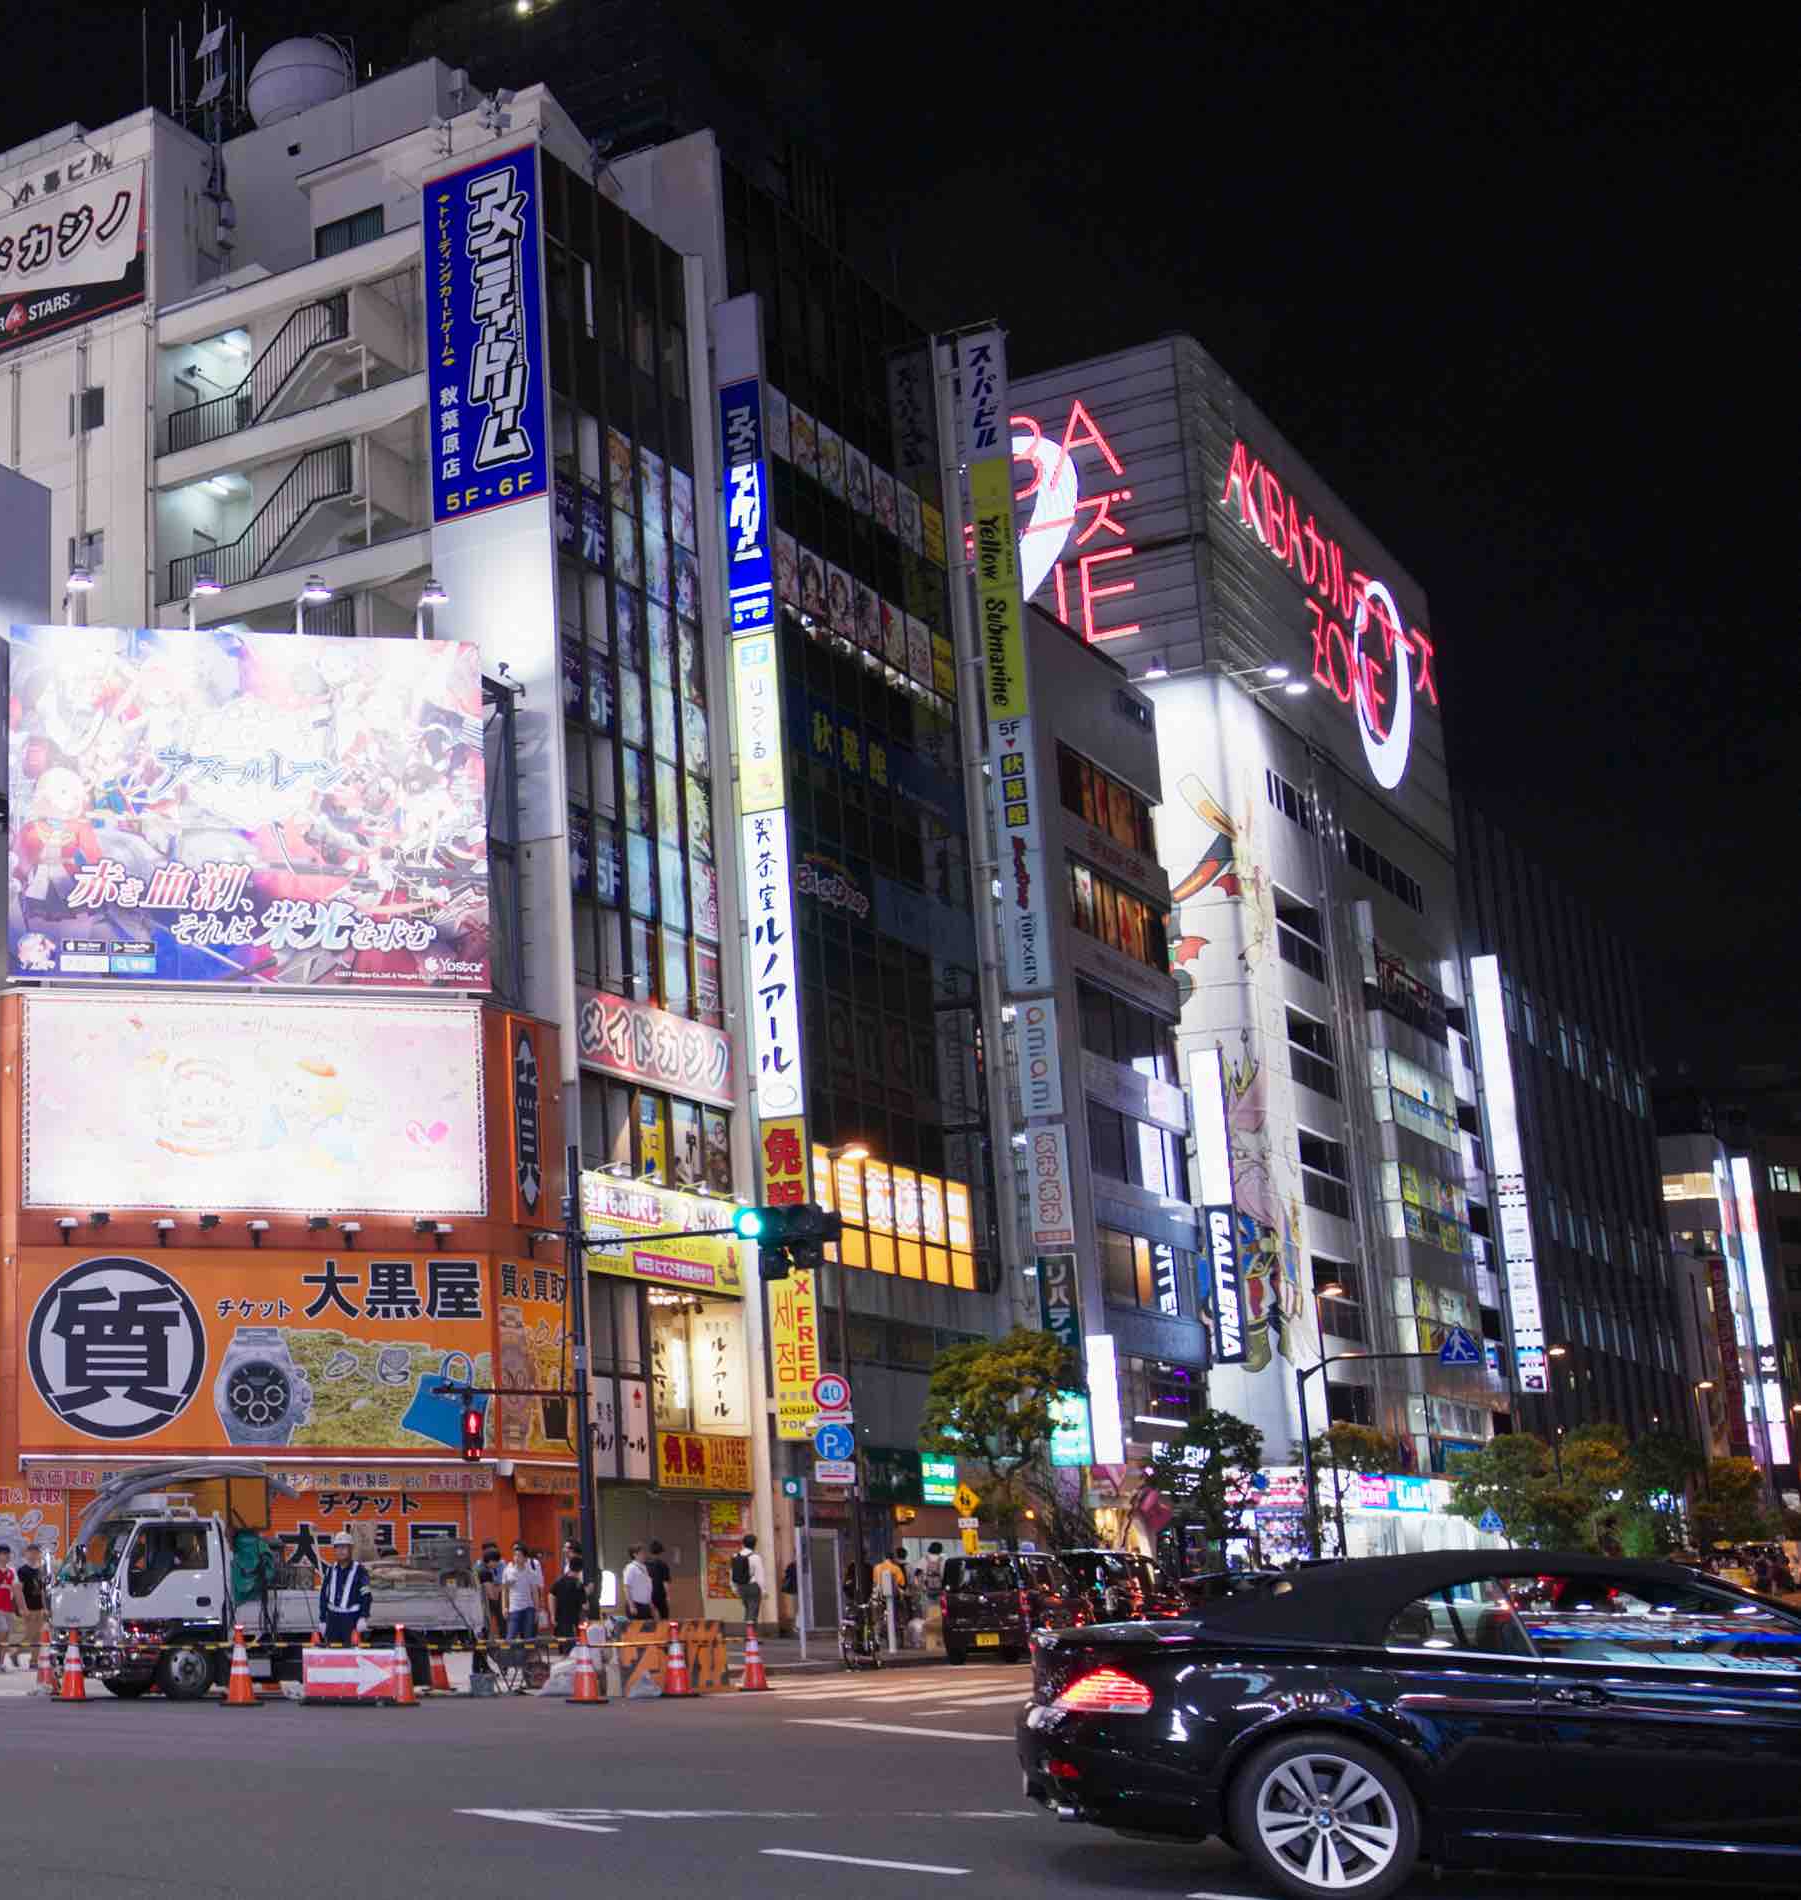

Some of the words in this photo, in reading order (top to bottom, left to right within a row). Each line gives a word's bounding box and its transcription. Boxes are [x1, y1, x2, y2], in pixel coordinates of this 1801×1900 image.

[27, 292, 71, 321] STARS
[440, 384, 460, 480] 秋葉原店
[967, 344, 999, 450] スーパービル
[978, 513, 999, 581] Yellow
[999, 720, 1020, 736] 5F
[440, 957, 484, 973] Yostar
[579, 998, 729, 1089] メイドカジノ
[1025, 1006, 1053, 1110] amiami
[1034, 1131, 1063, 1225] あみあみ
[216, 1299, 293, 1318] チケット
[302, 1259, 484, 1320] 大黒屋
[1208, 1210, 1244, 1359] GALLERIA
[46, 1285, 187, 1417] 質
[711, 1336, 730, 1418] ルノアール
[795, 1305, 817, 1382] FREE
[821, 1384, 842, 1401] 40
[822, 1433, 839, 1457] P
[319, 1491, 422, 1515] チケット
